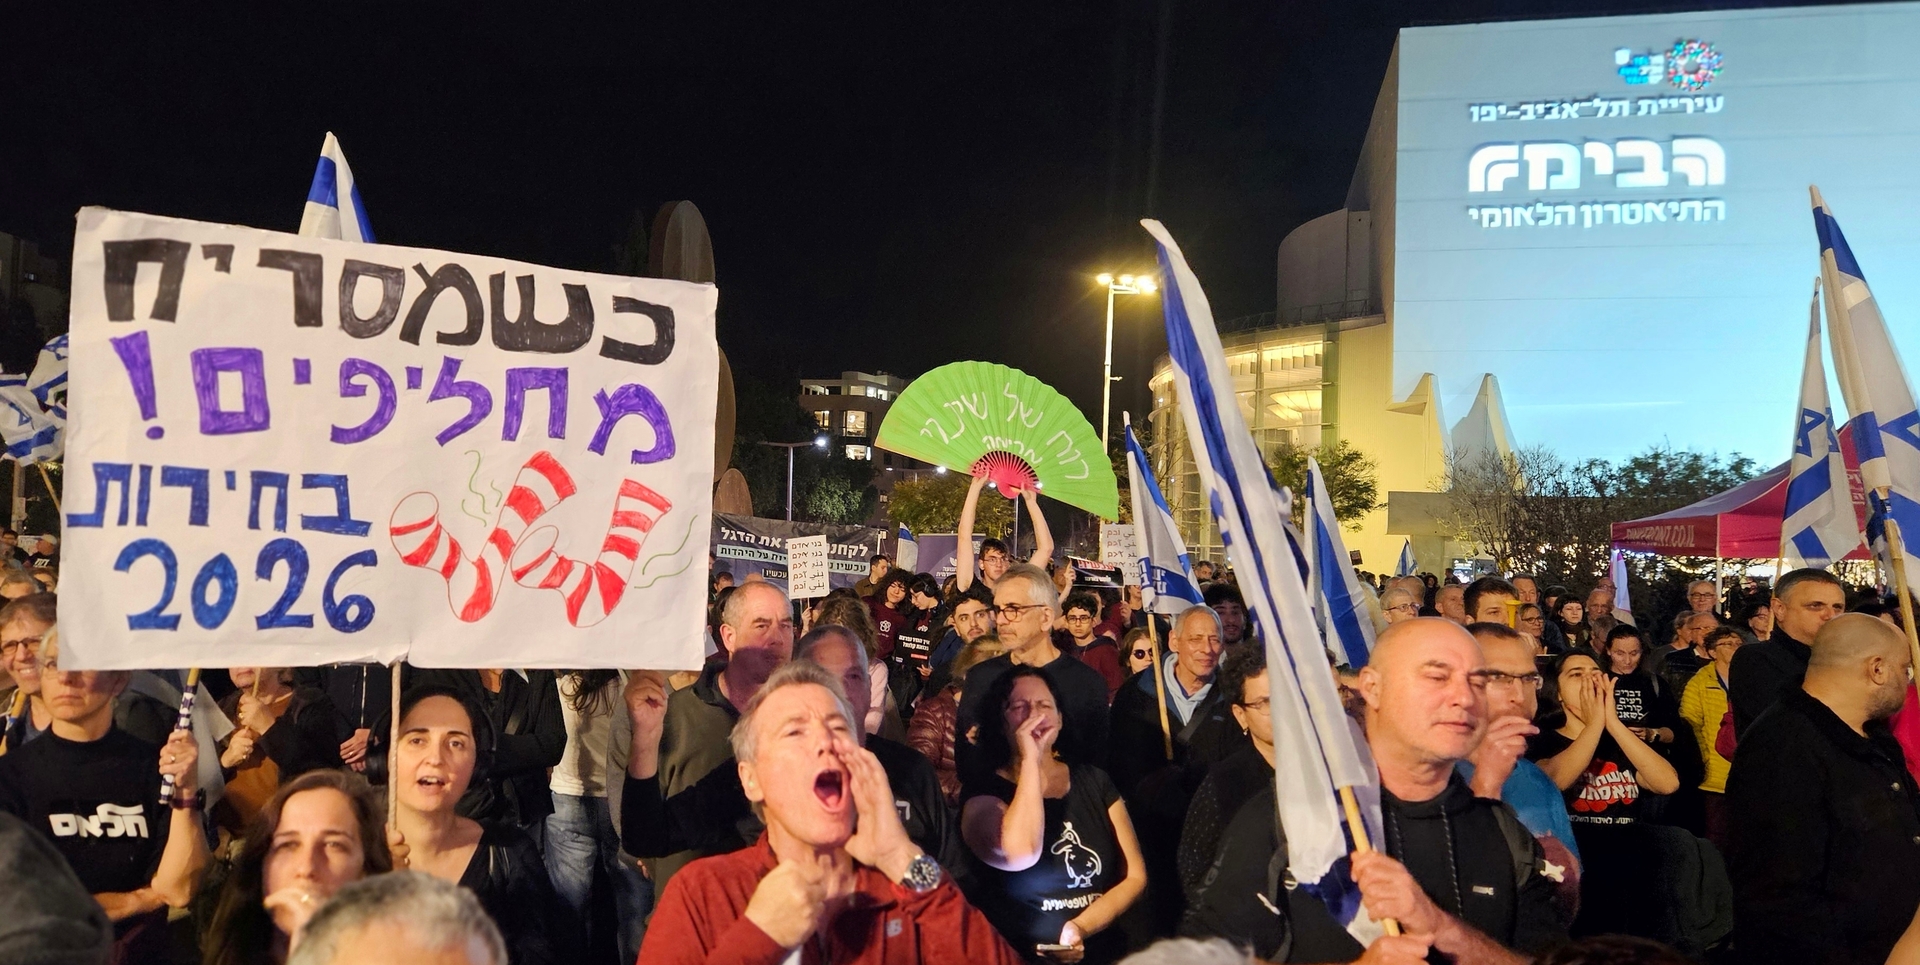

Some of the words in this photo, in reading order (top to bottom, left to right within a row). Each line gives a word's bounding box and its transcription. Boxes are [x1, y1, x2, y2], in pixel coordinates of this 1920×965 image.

[1636, 95, 1725, 116] עיריית
[1468, 138, 1726, 192] הבימה
[1468, 202, 1576, 228] הלאומי
[1579, 199, 1726, 228] התיאטרון
[103, 238, 676, 365] כשמסריח
[111, 330, 676, 464] מחליפים!
[1003, 382, 1043, 429] של
[1047, 430, 1089, 479] רוח
[66, 462, 373, 537] בחירות
[720, 526, 756, 543] הדגל
[758, 535, 782, 549] את
[720, 546, 755, 558] היהדות
[756, 548, 770, 559] על
[836, 562, 867, 573] עכשיו
[113, 537, 378, 633] 2026
[1616, 704, 1643, 712] קורים
